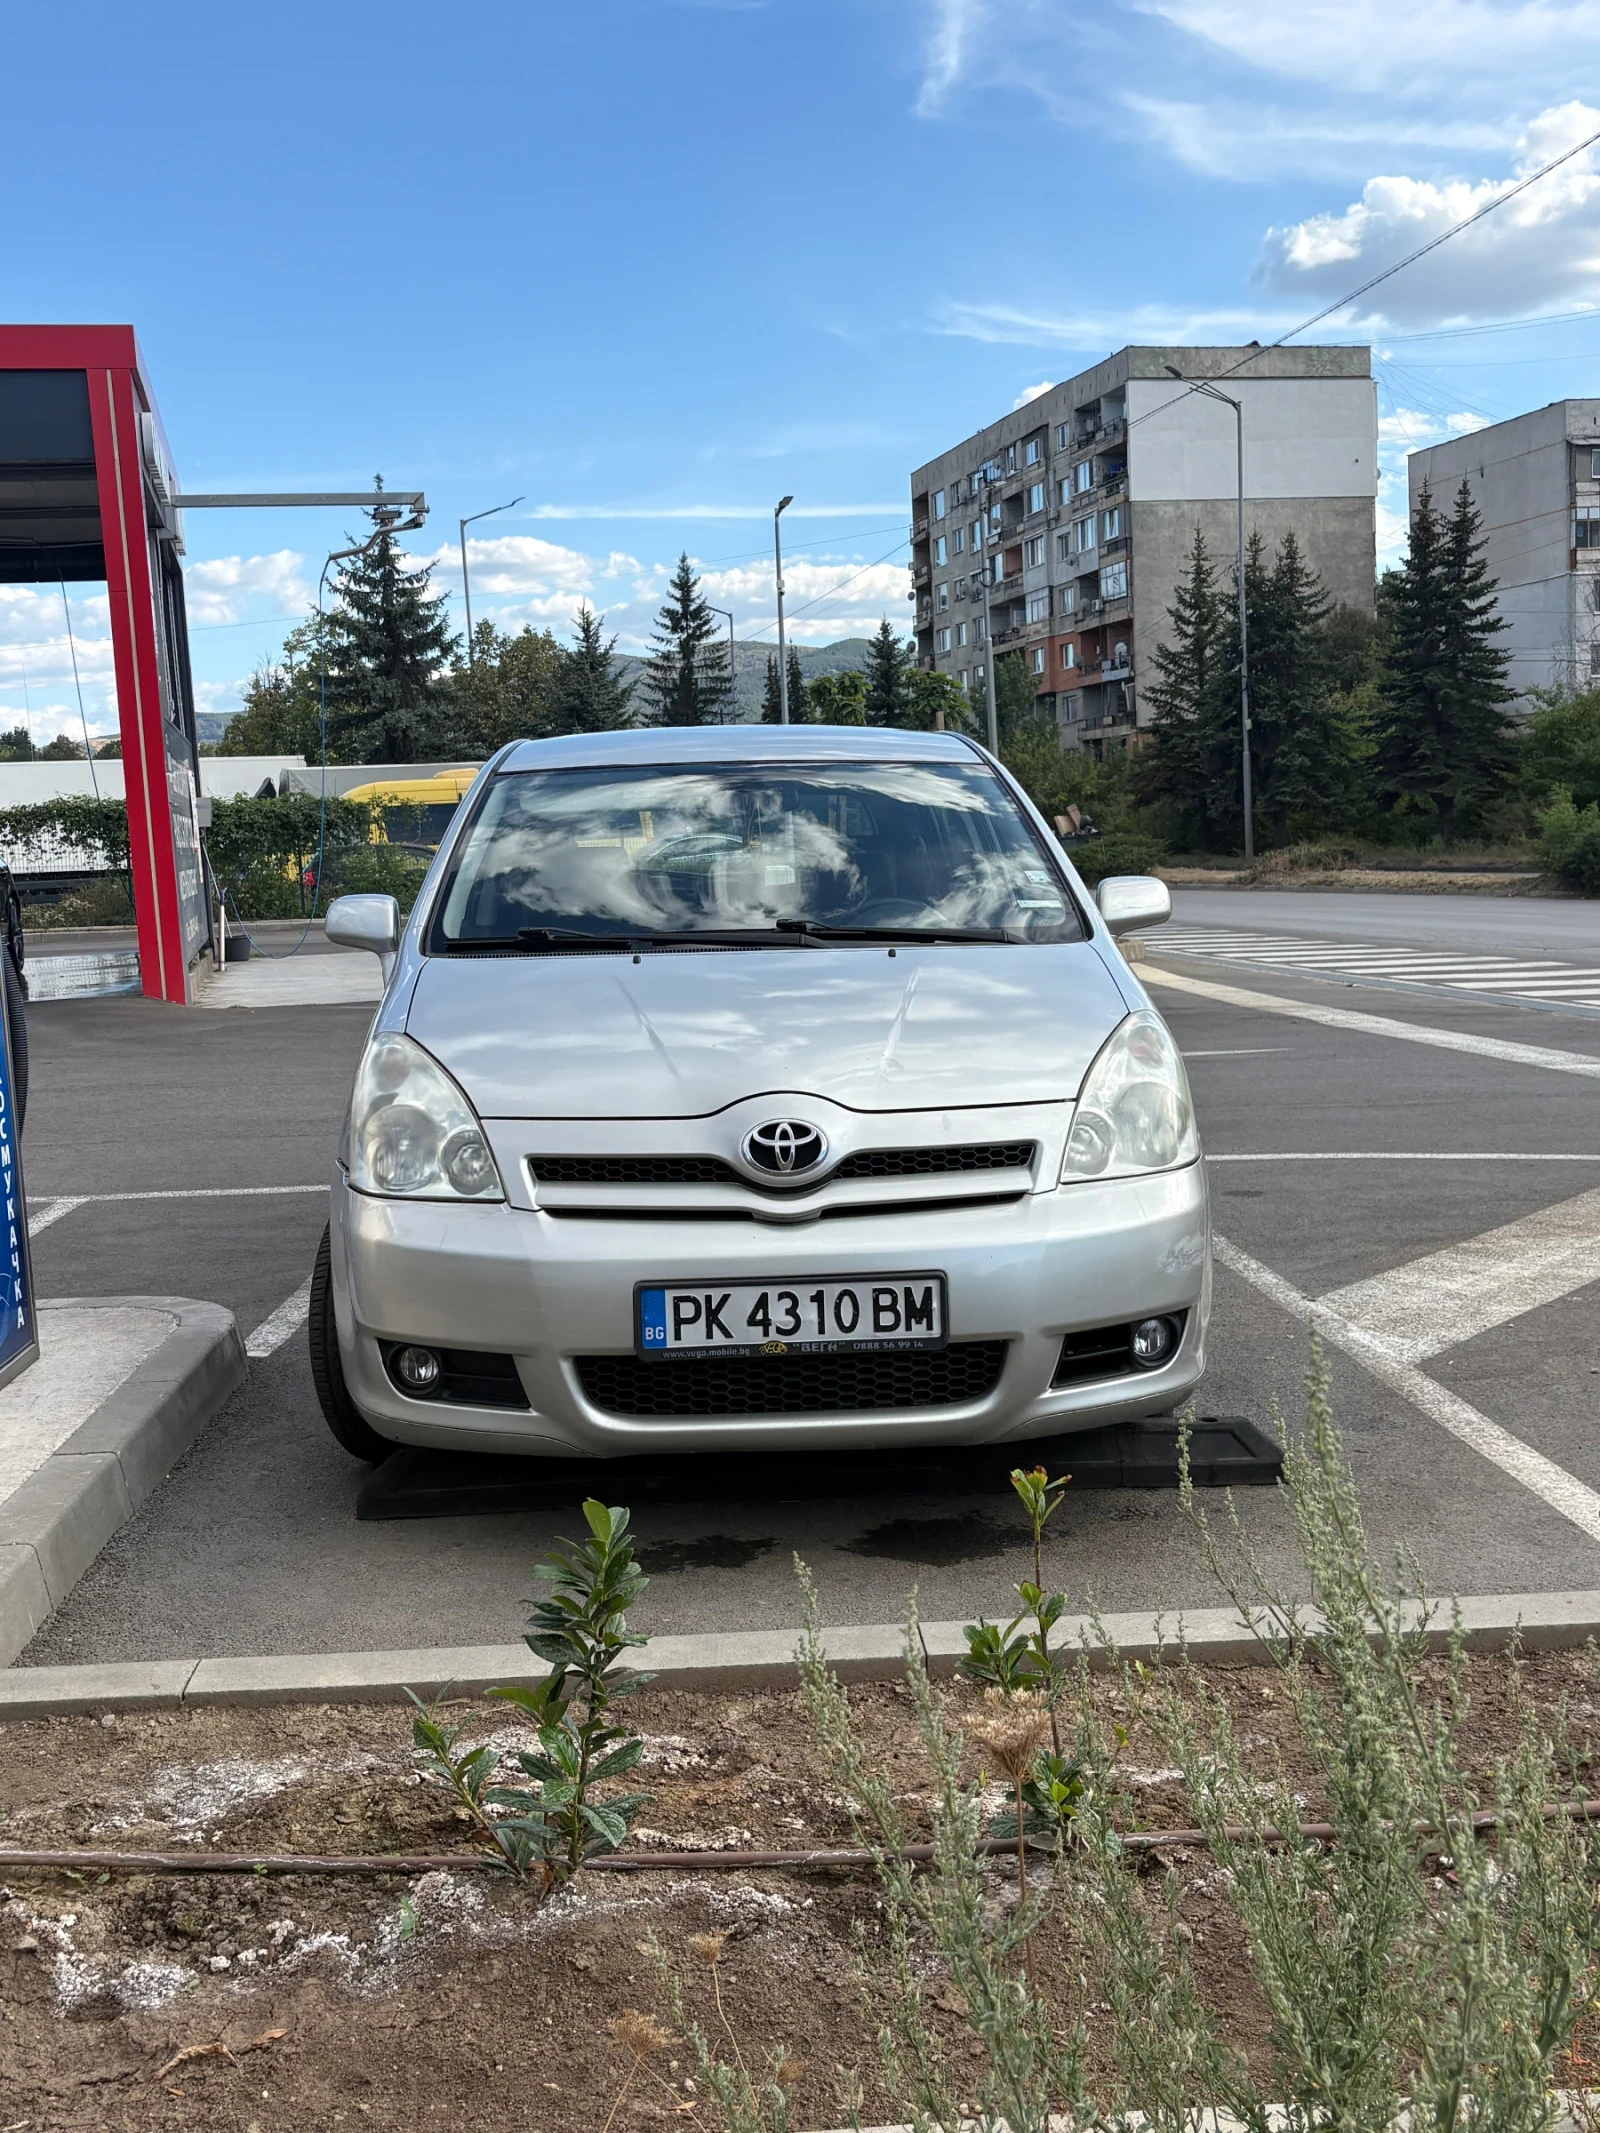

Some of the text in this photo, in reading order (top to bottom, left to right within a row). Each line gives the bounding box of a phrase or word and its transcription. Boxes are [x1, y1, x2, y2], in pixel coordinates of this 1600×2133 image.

[0, 1077, 25, 1329] ОСМУКАЧКА
[673, 1286, 934, 1341] PK 4310 BM
[645, 1327, 664, 1340] BG
[853, 1342, 880, 1350] 0888
[882, 1341, 895, 1349] 56
[898, 1341, 911, 1349] 99
[913, 1340, 924, 1348] 14
[662, 1347, 750, 1359] www.vega.mobile.bg
